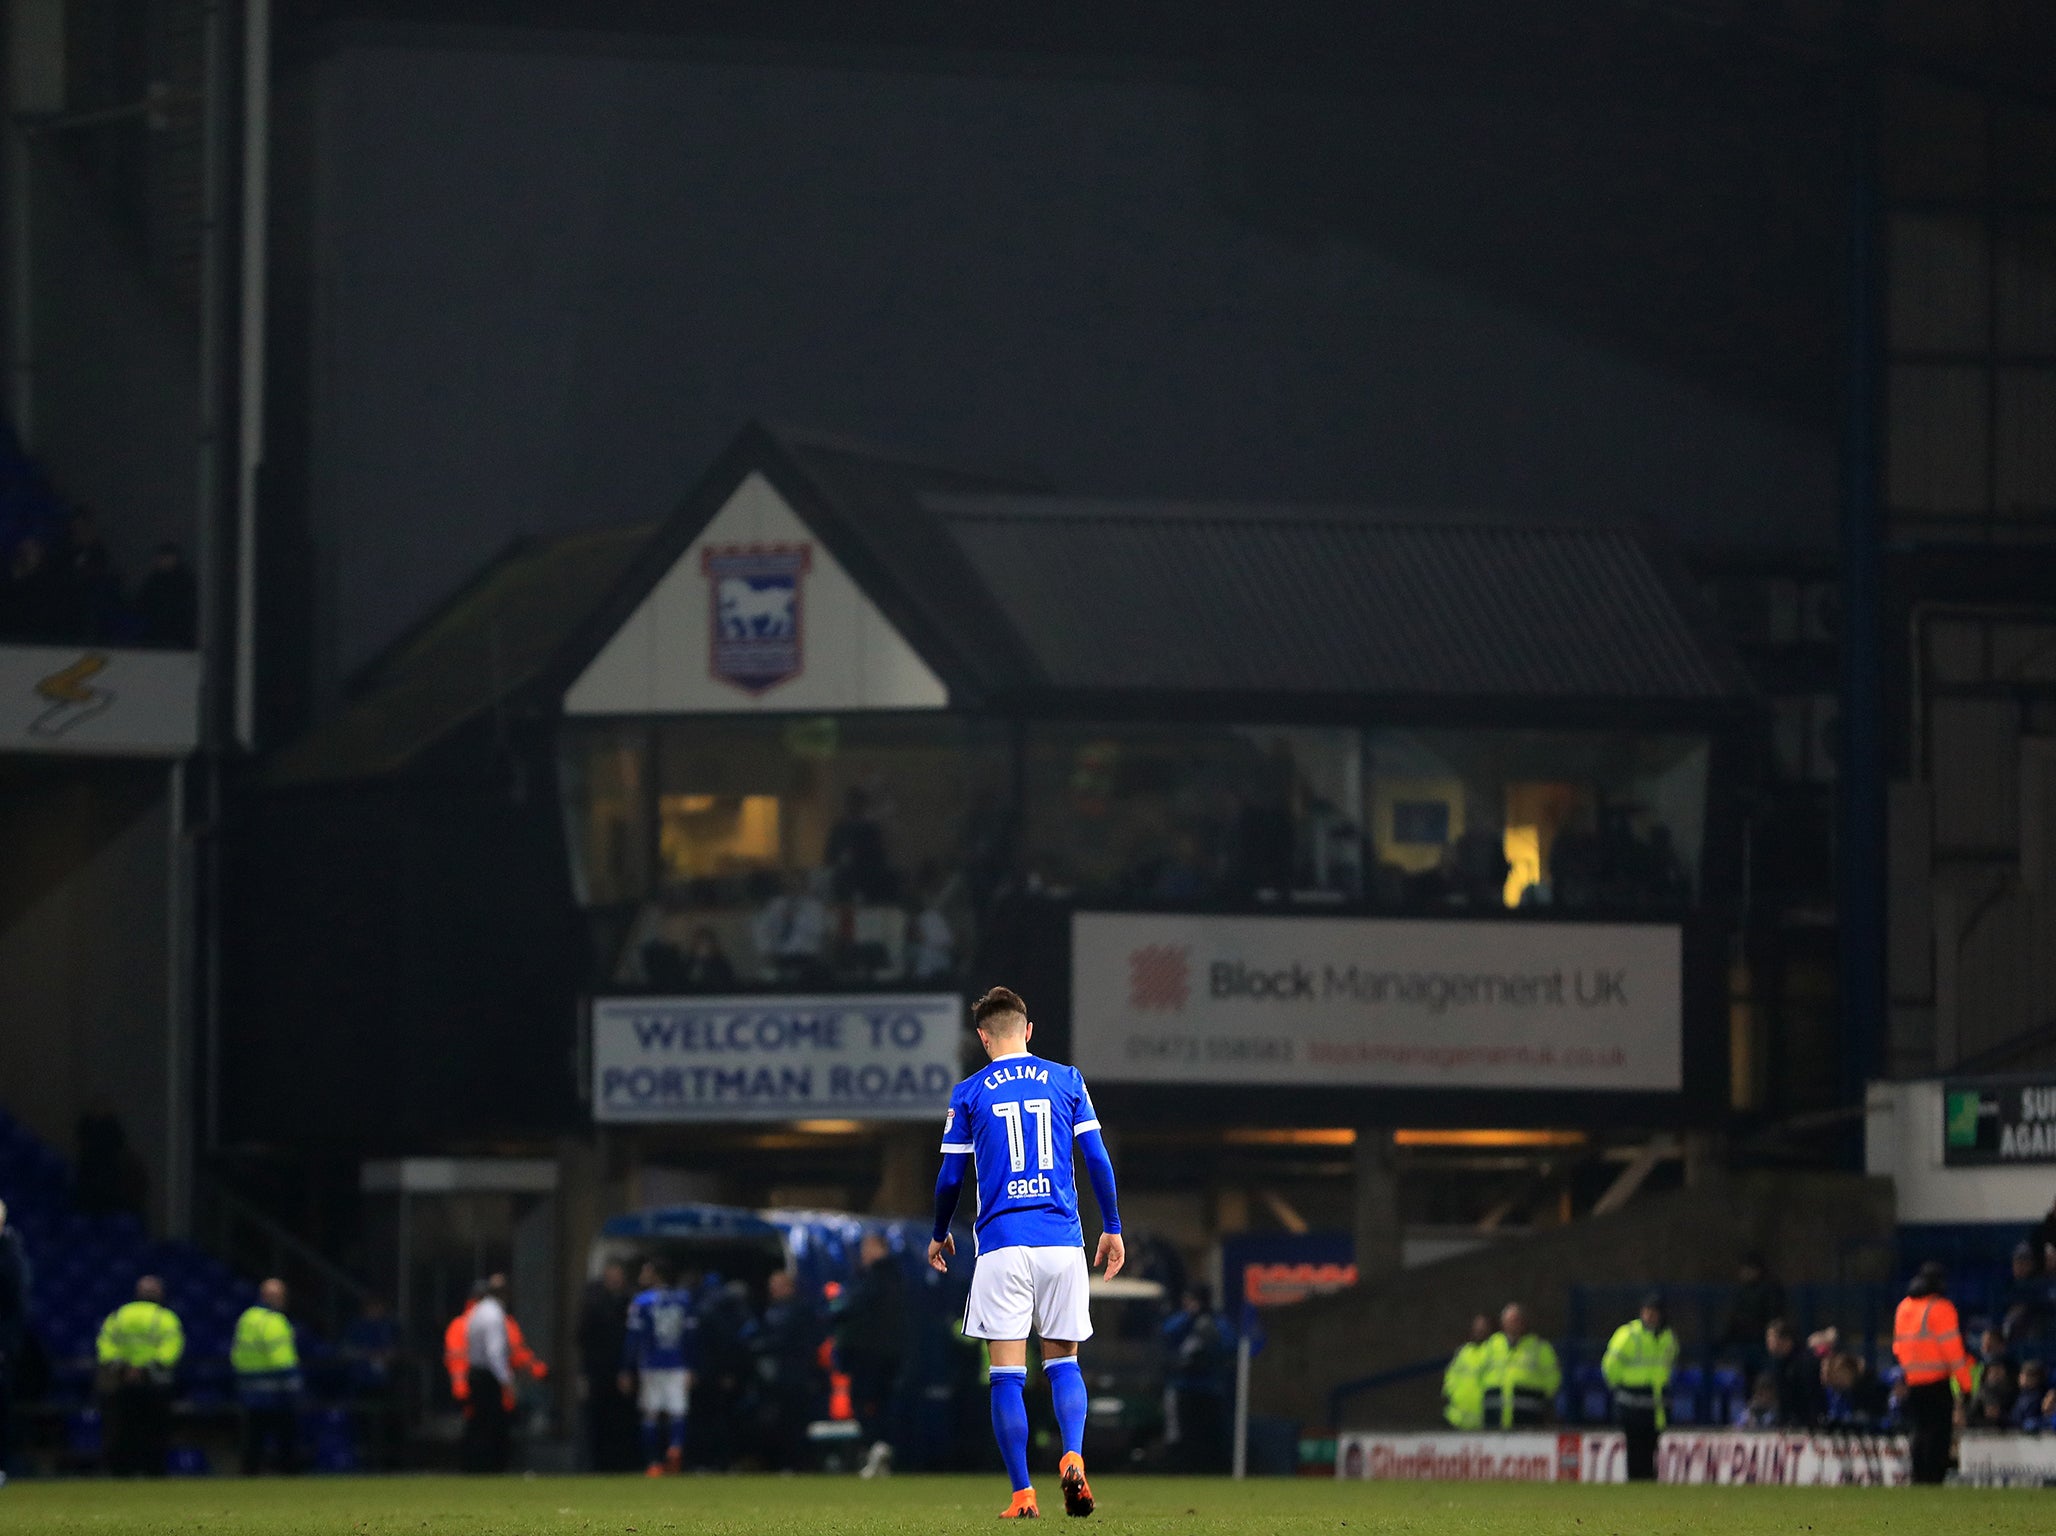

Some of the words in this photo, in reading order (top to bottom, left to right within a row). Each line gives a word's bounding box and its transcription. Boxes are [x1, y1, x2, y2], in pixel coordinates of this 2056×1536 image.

[1209, 960, 1315, 1001] Block
[1322, 963, 1565, 1014] Management
[1574, 968, 1629, 1007] UK
[632, 1016, 842, 1050] WELCOME
[866, 1014, 925, 1049] TO
[602, 1066, 811, 1097] PORTMAN
[829, 1065, 953, 1095] ROAD
[984, 1065, 1049, 1090] CELINA
[992, 1098, 1054, 1173] 11
[1007, 1172, 1051, 1195] each
